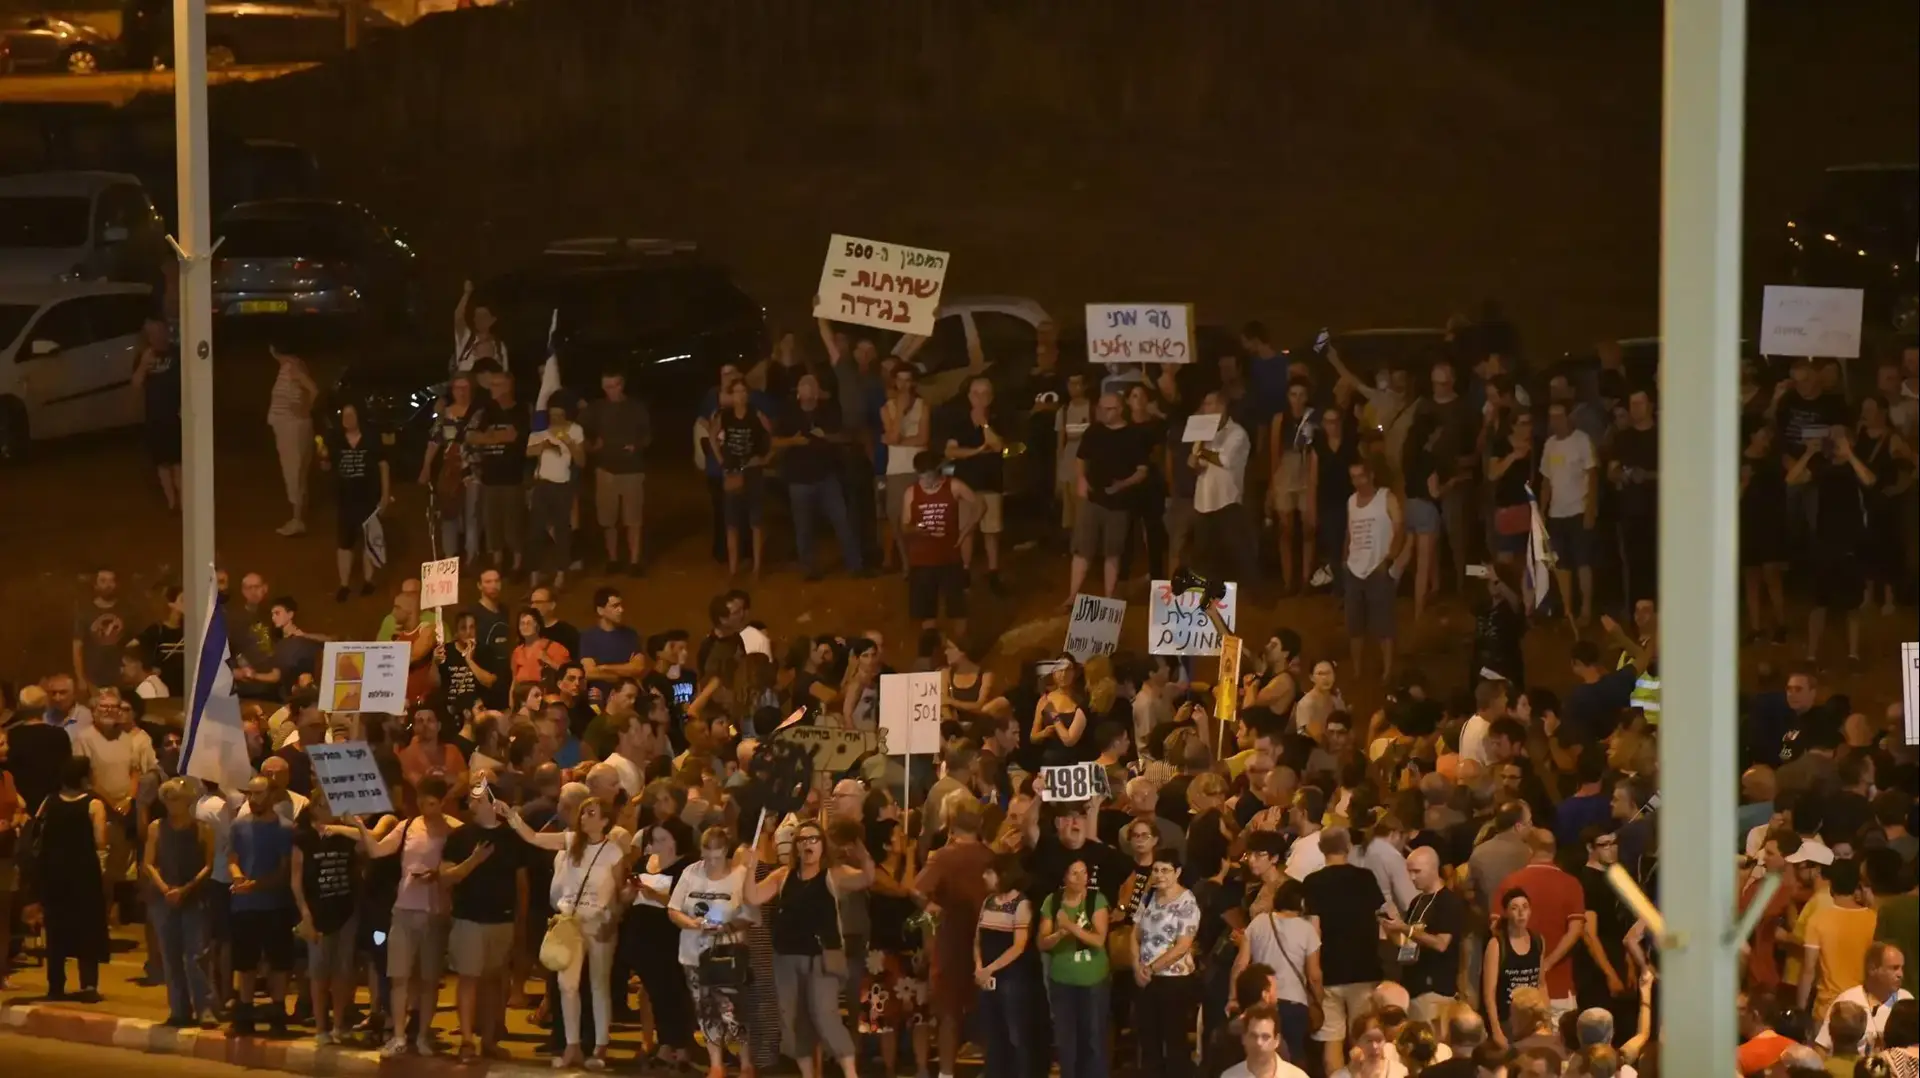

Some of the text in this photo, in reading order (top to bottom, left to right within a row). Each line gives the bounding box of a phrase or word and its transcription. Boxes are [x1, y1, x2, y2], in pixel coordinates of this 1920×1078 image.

[851, 270, 940, 298] שחיתות
[841, 292, 911, 323] בגידה
[914, 682, 938, 698] אני
[913, 703, 938, 722] 501
